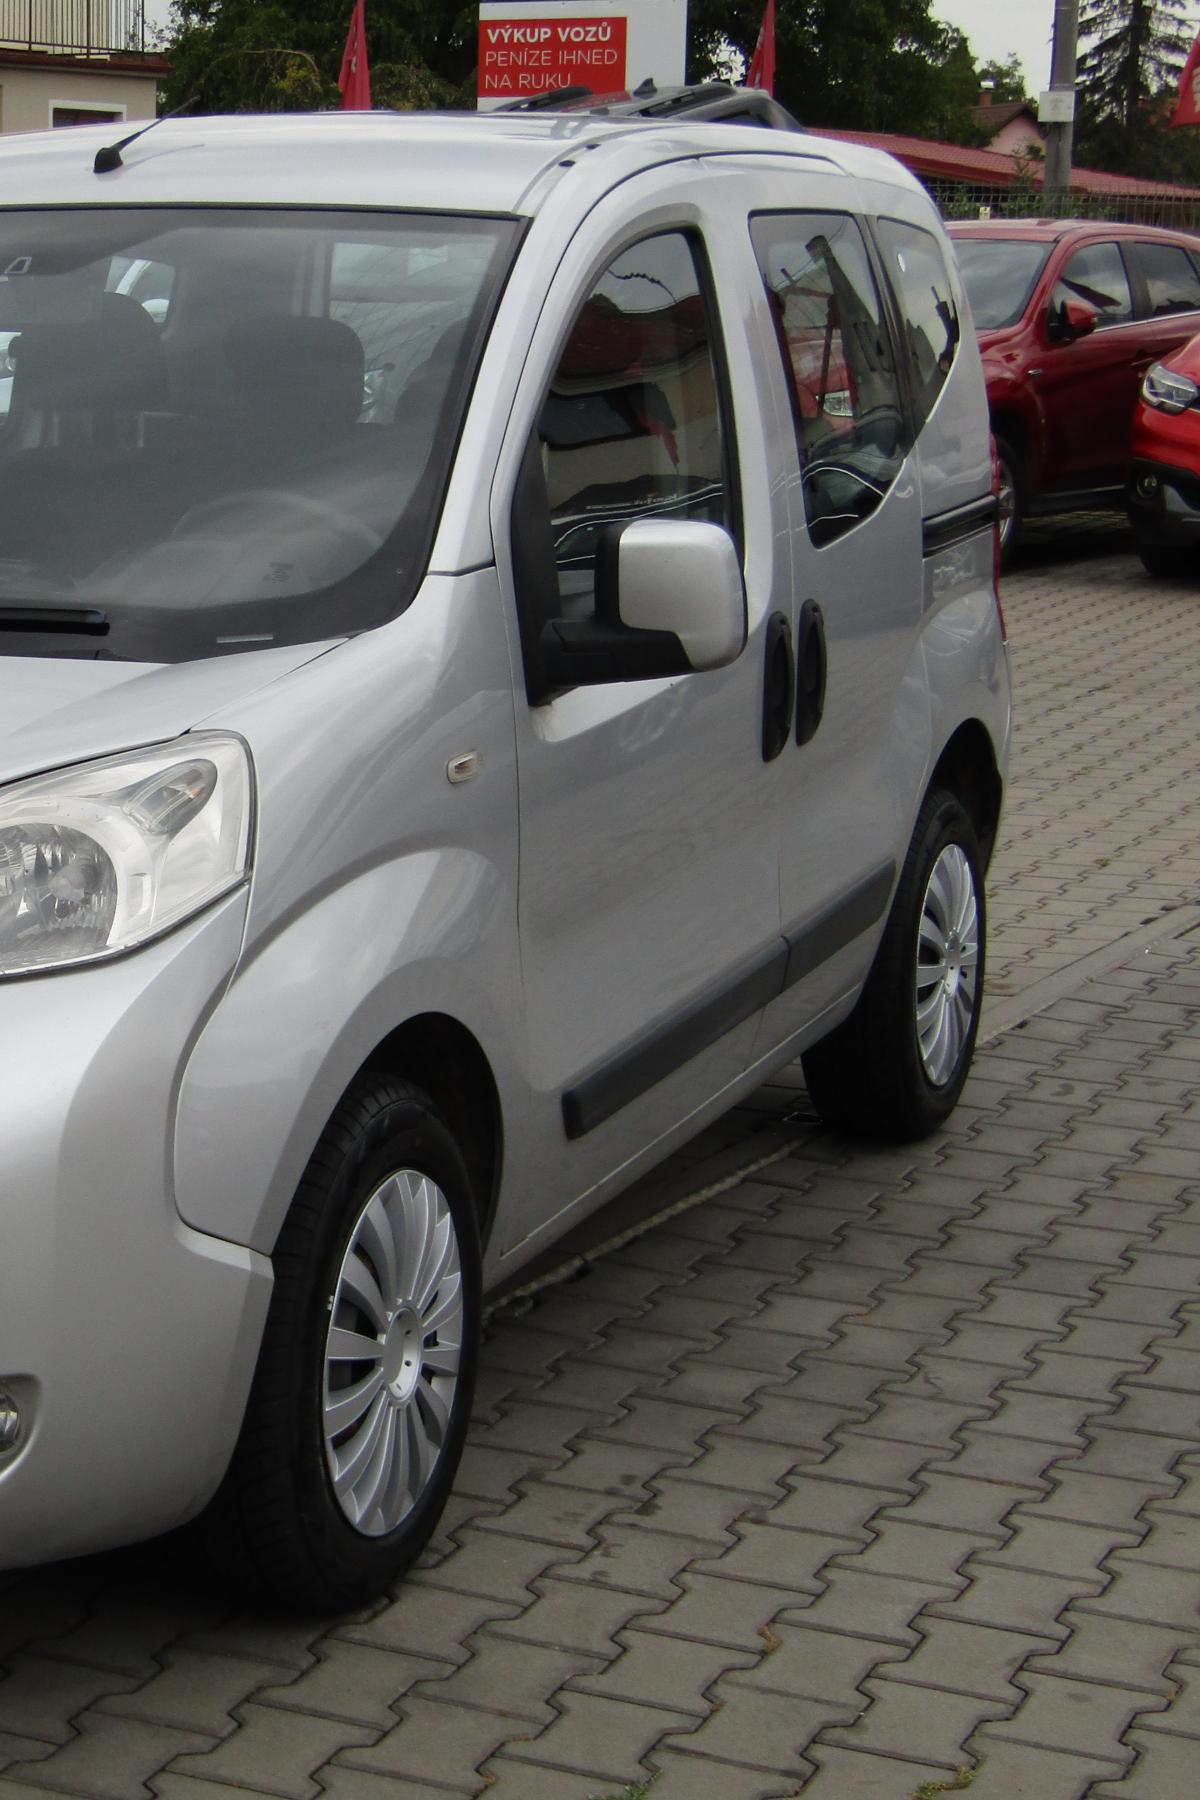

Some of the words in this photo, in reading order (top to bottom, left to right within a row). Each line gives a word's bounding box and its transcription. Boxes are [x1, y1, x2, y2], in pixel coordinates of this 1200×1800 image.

[487, 25, 551, 43] VÝKUP
[557, 22, 611, 42] VOZŮ
[485, 48, 552, 66] PENÍZE
[558, 49, 618, 65] IHNED
[485, 74, 512, 89] NA
[518, 73, 571, 88] RUKU
